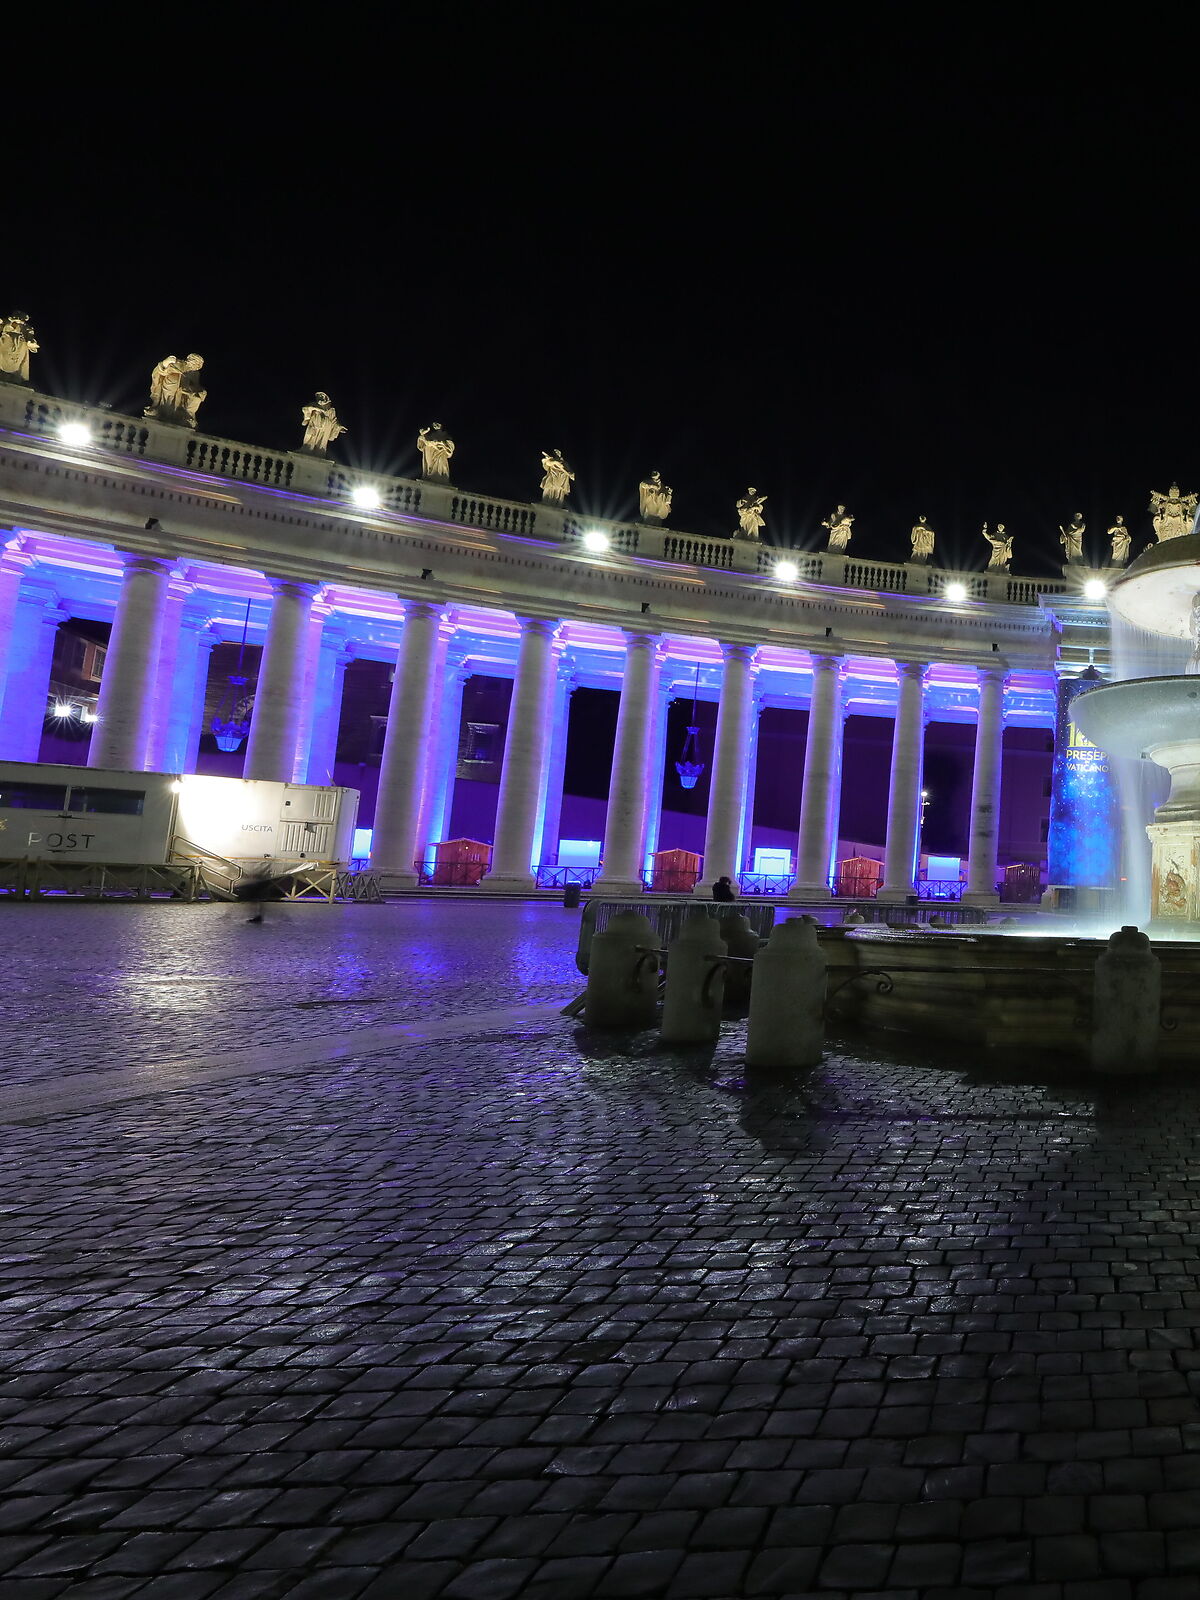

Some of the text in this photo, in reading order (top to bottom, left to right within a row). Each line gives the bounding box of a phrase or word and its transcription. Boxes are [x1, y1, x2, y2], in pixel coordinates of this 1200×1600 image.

[1066, 763, 1109, 773] VATICANO
[241, 824, 273, 833] USCITA
[28, 832, 96, 849] POST
